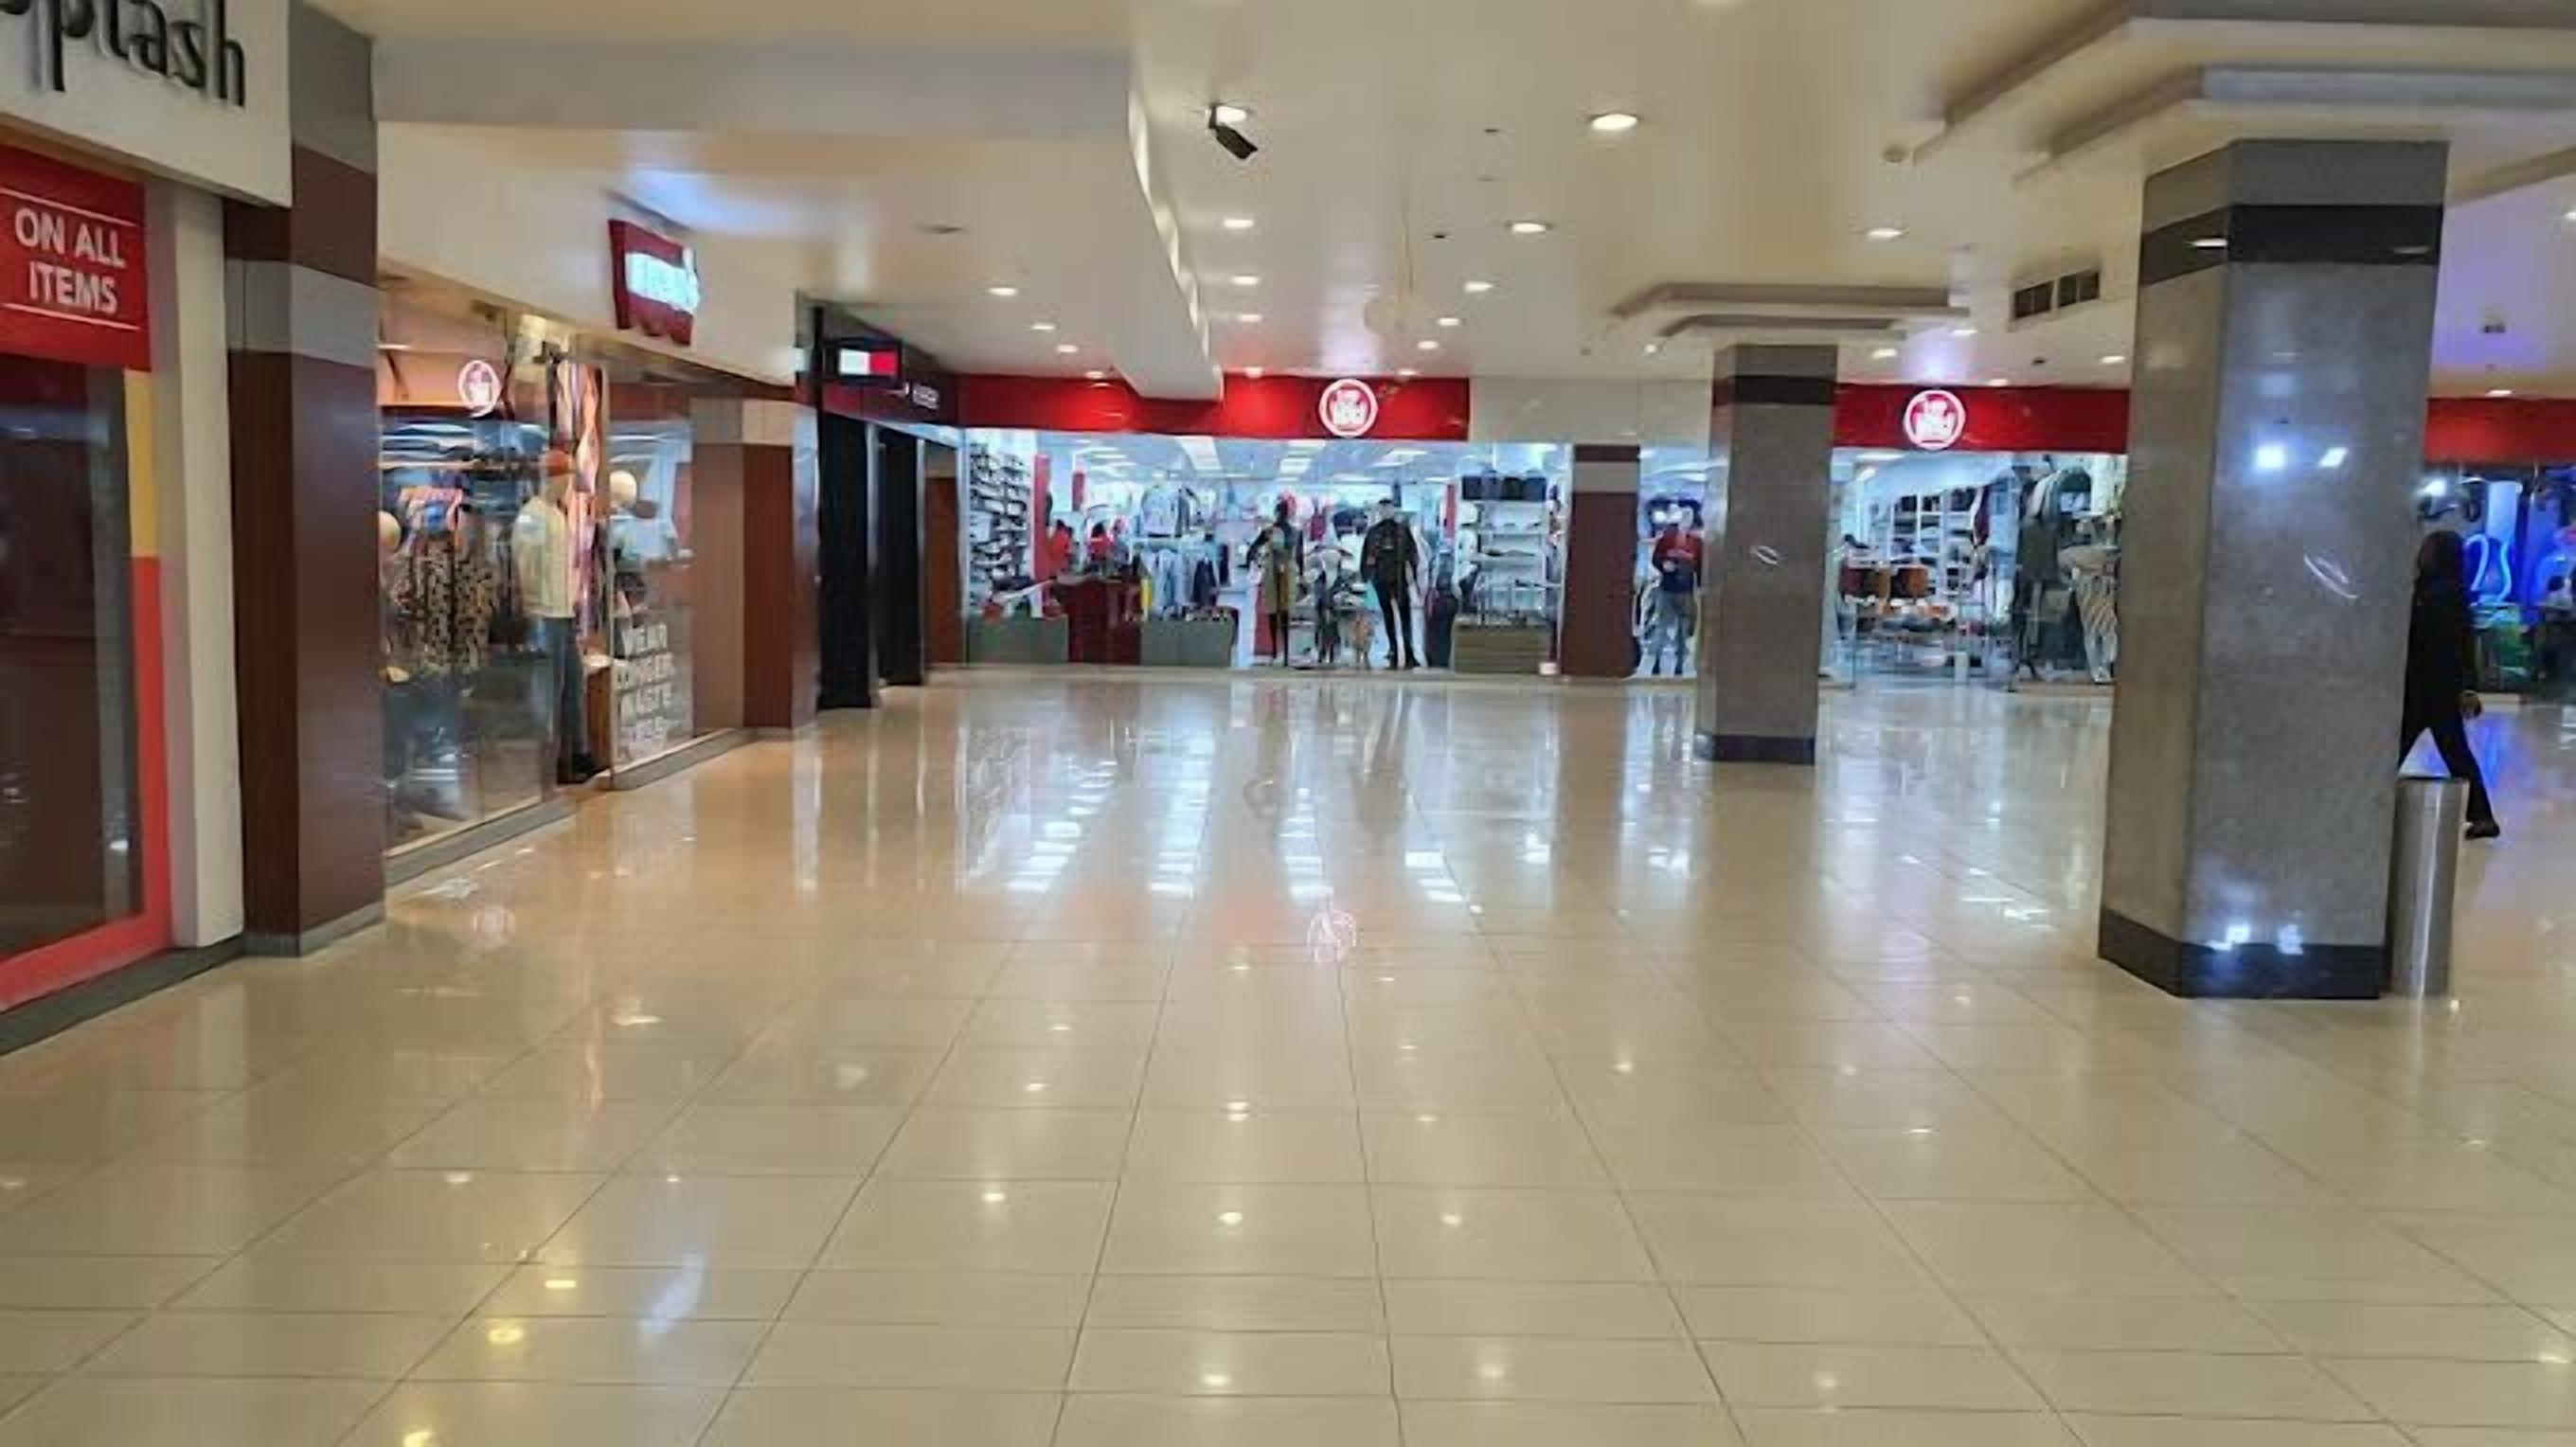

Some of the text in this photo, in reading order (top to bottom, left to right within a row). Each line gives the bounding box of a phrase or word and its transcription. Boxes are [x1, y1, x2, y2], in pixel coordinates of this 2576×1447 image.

[0, 0, 246, 107] plash
[14, 207, 127, 269] ON ALL
[29, 260, 119, 315] ITEMS
